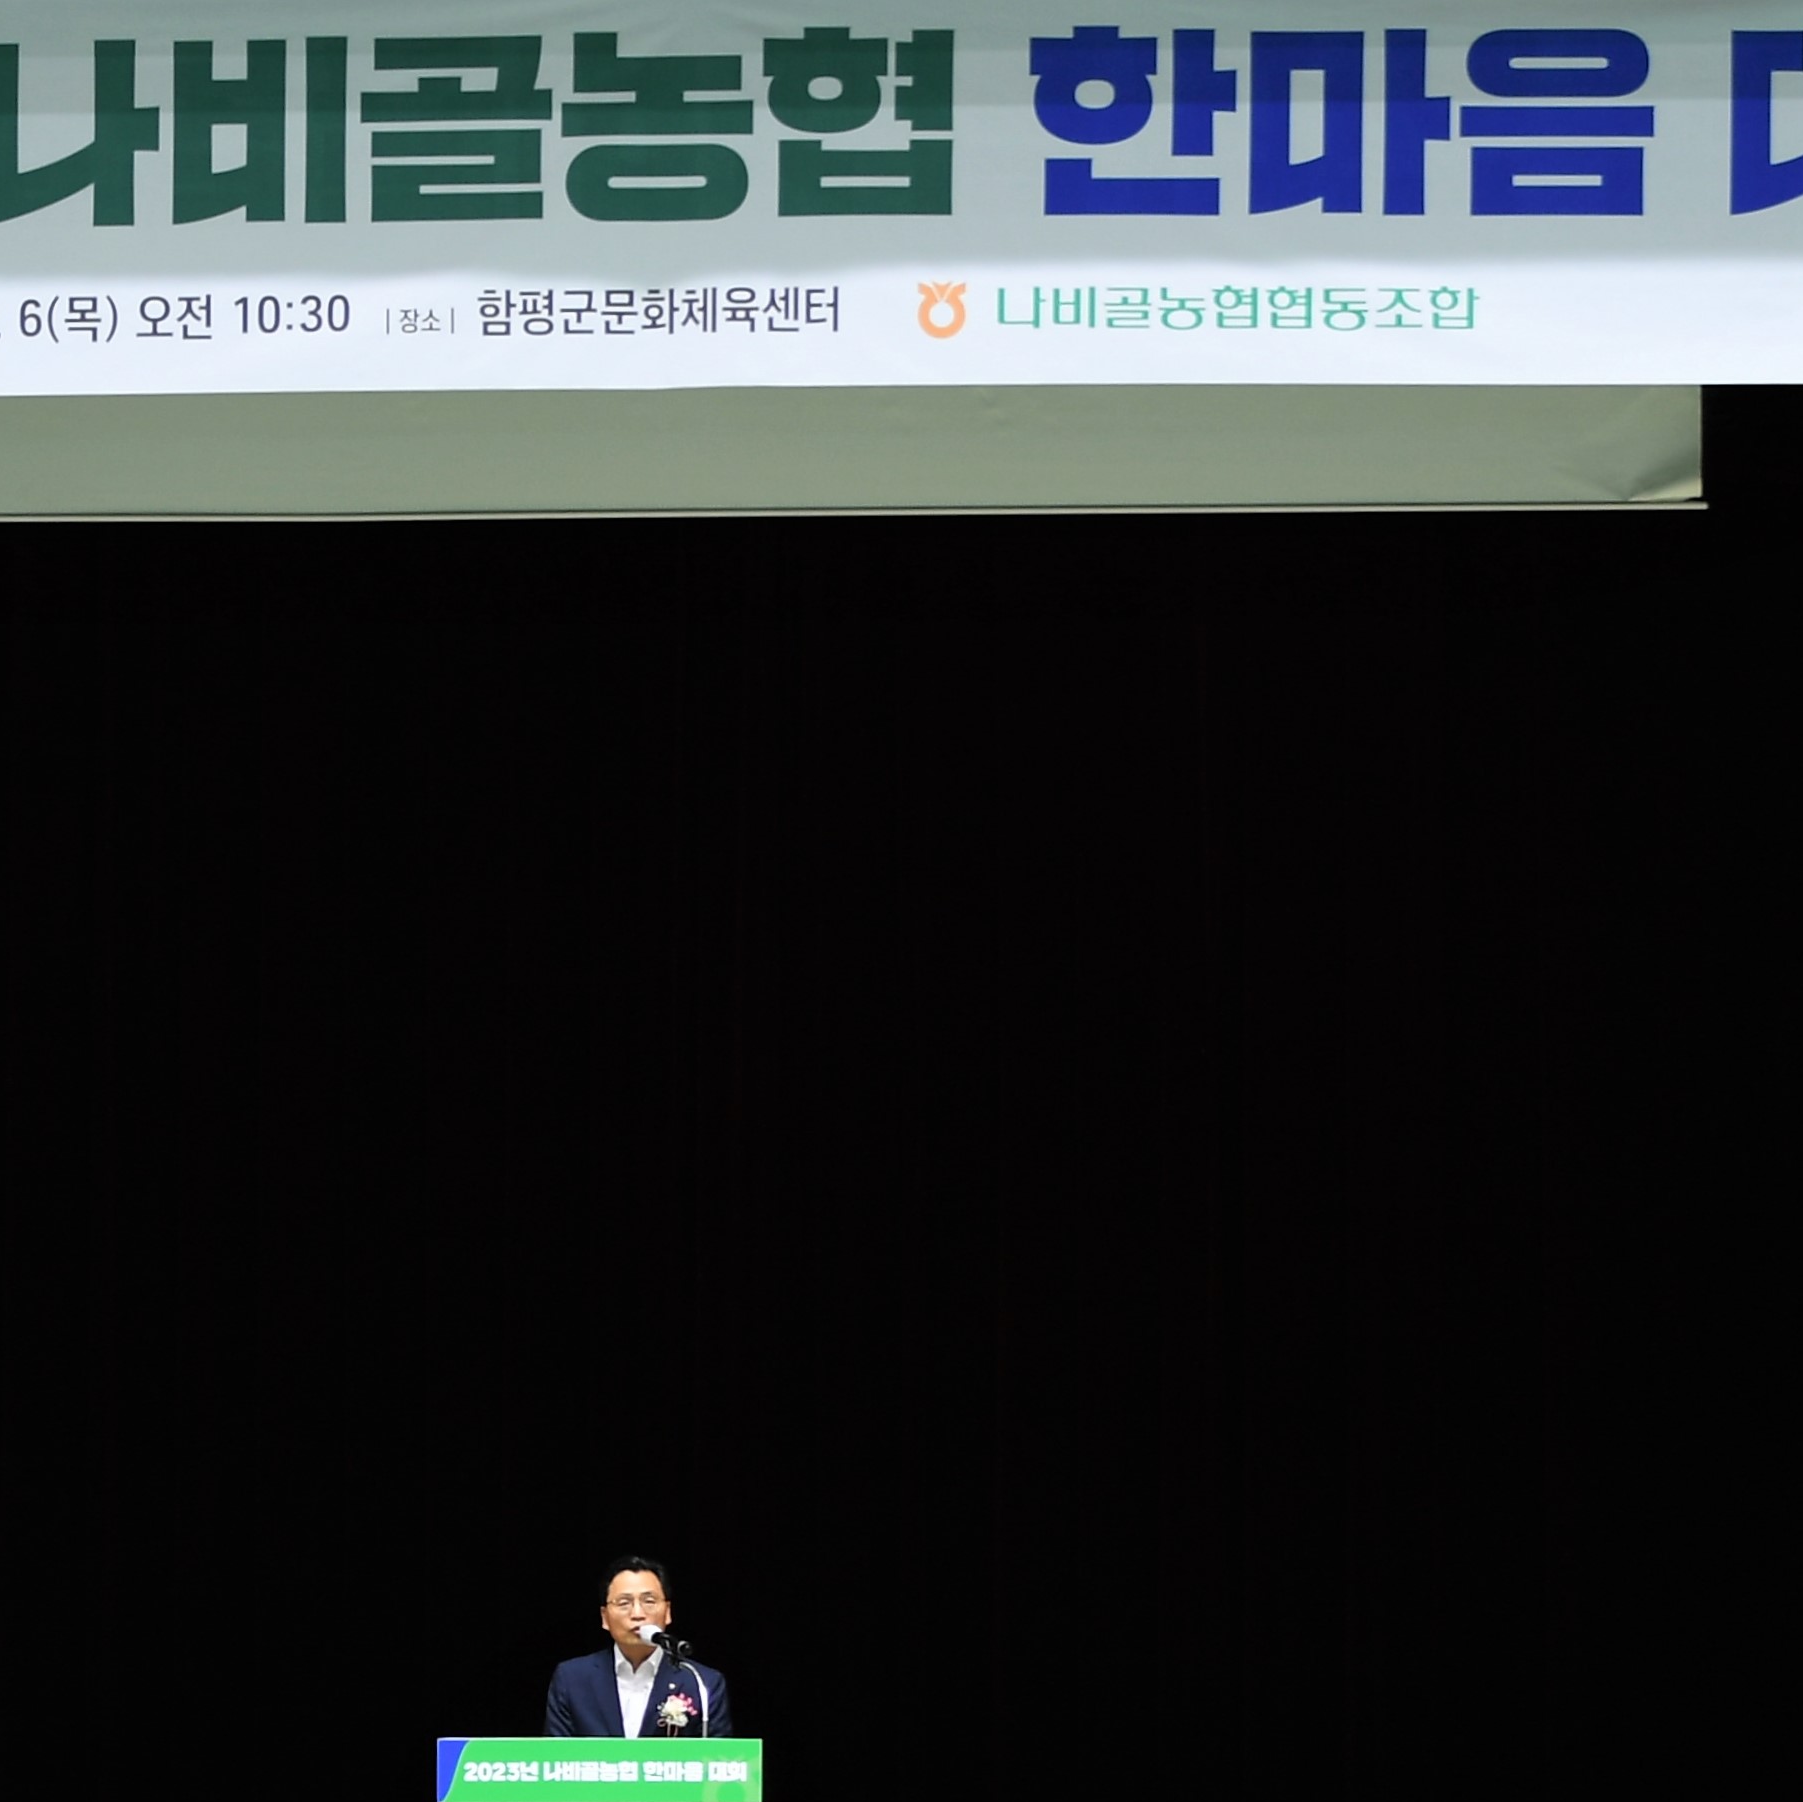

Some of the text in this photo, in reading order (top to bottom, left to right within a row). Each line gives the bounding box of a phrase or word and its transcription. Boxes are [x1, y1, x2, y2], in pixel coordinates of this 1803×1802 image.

[1028, 24, 1656, 218] 한마음
[19, 294, 118, 343] 6(목)
[136, 294, 213, 340] 오전
[234, 294, 350, 334] 10:30
[477, 286, 840, 336] 함평군문화체육센터
[997, 285, 1480, 331] 나비골농협협동조합
[462, 1760, 539, 1783] 2023년
[707, 1760, 748, 1783] 대회
